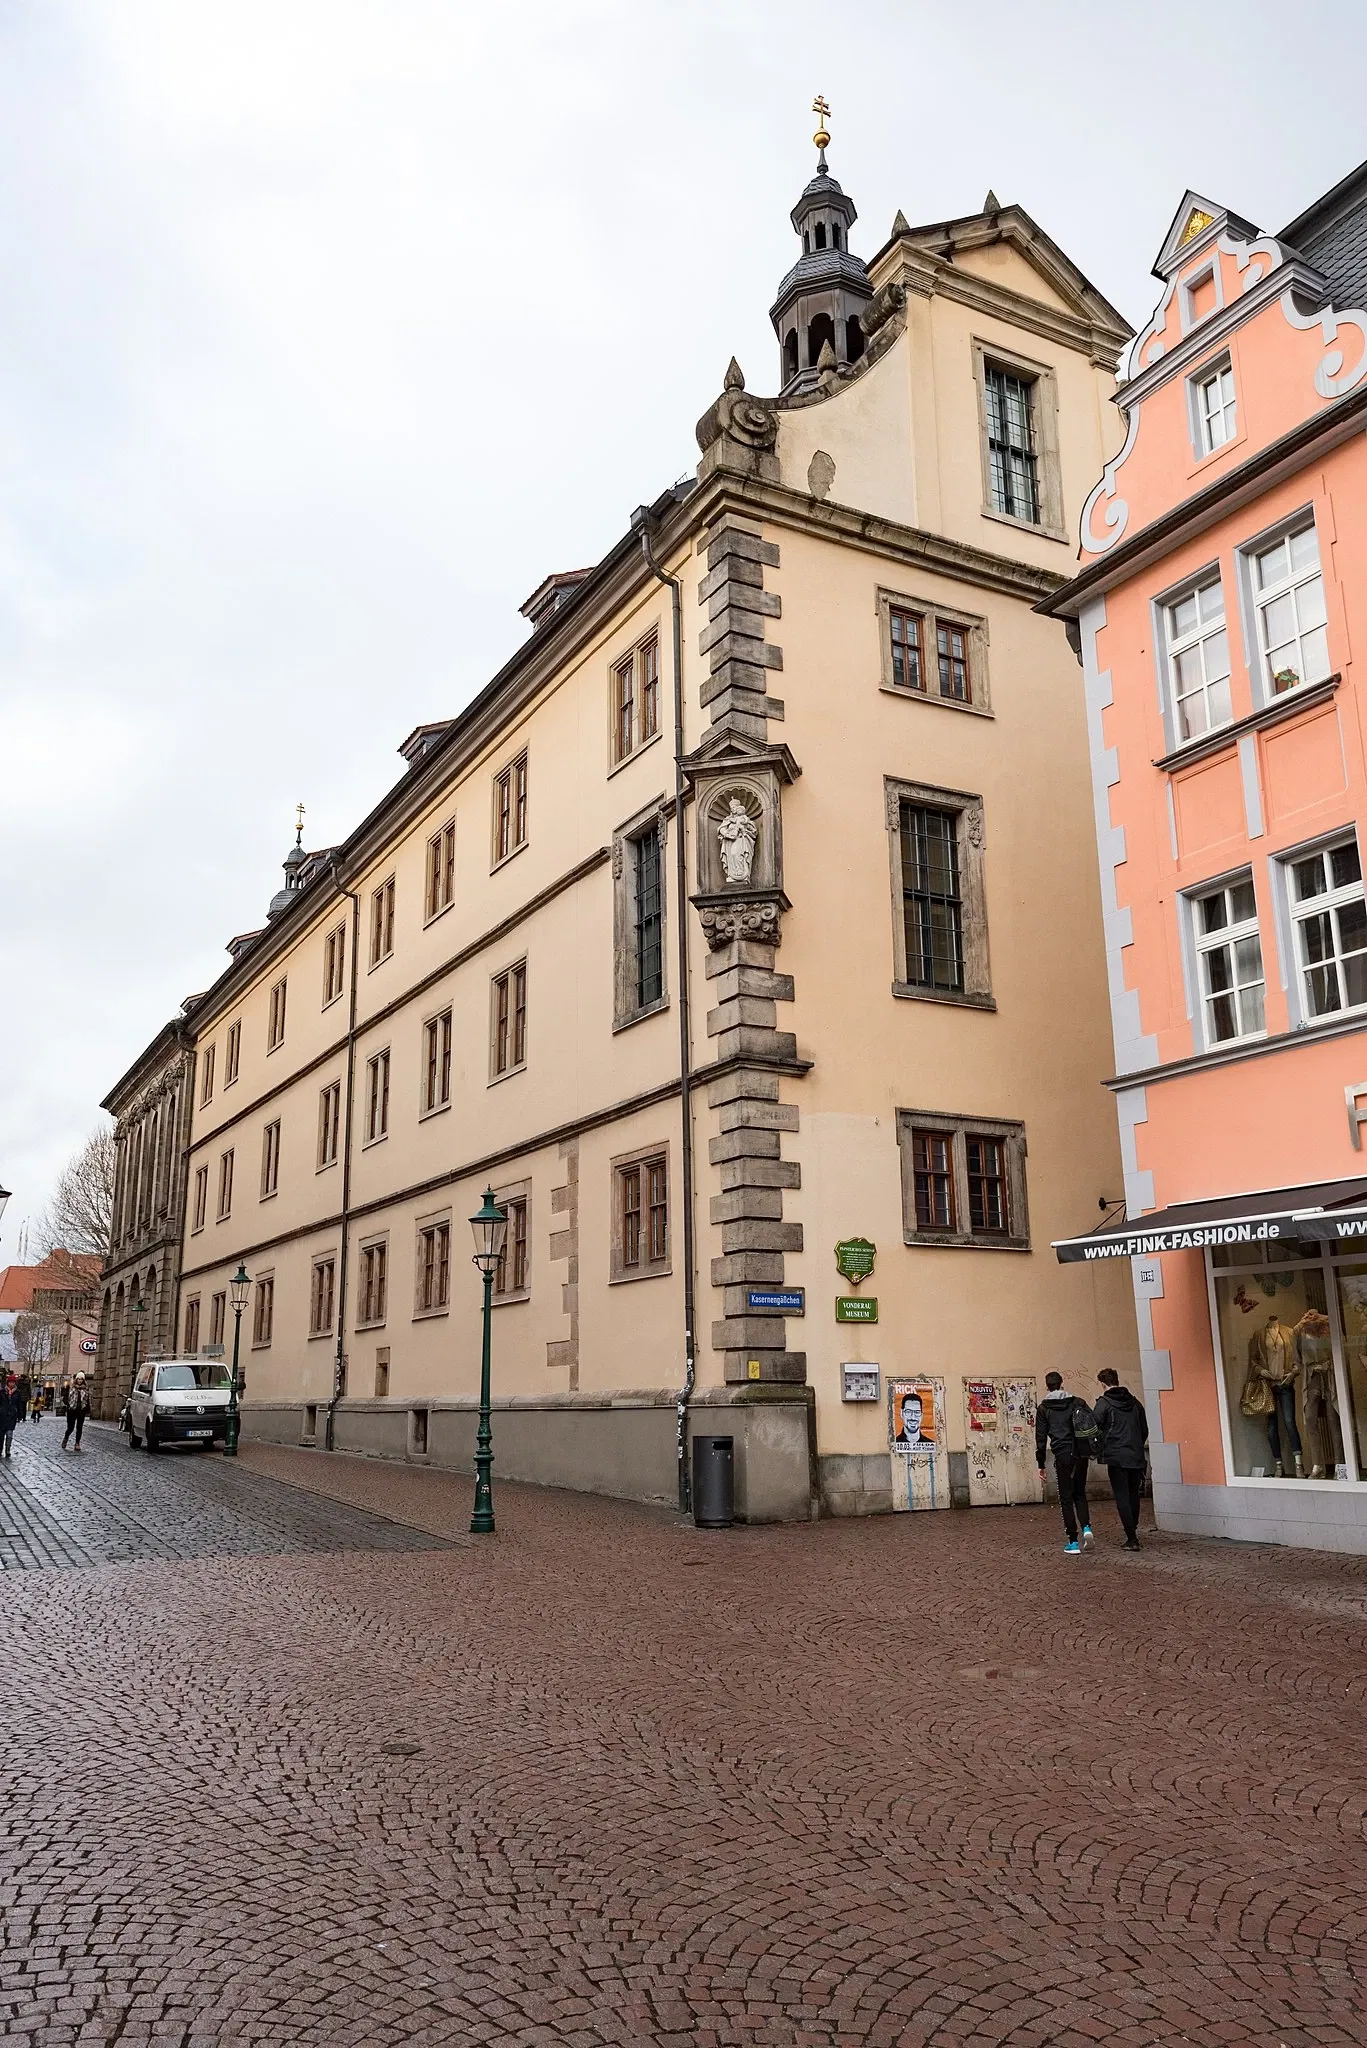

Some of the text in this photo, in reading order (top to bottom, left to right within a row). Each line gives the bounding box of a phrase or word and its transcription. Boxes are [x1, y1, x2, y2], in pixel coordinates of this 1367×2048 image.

[1084, 1221, 1280, 1259] www.FINK-FASHION.de
[751, 1294, 800, 1306] Kasernengäßchen
[845, 1310, 870, 1318] MUSEUM
[895, 1384, 917, 1395] RICK
